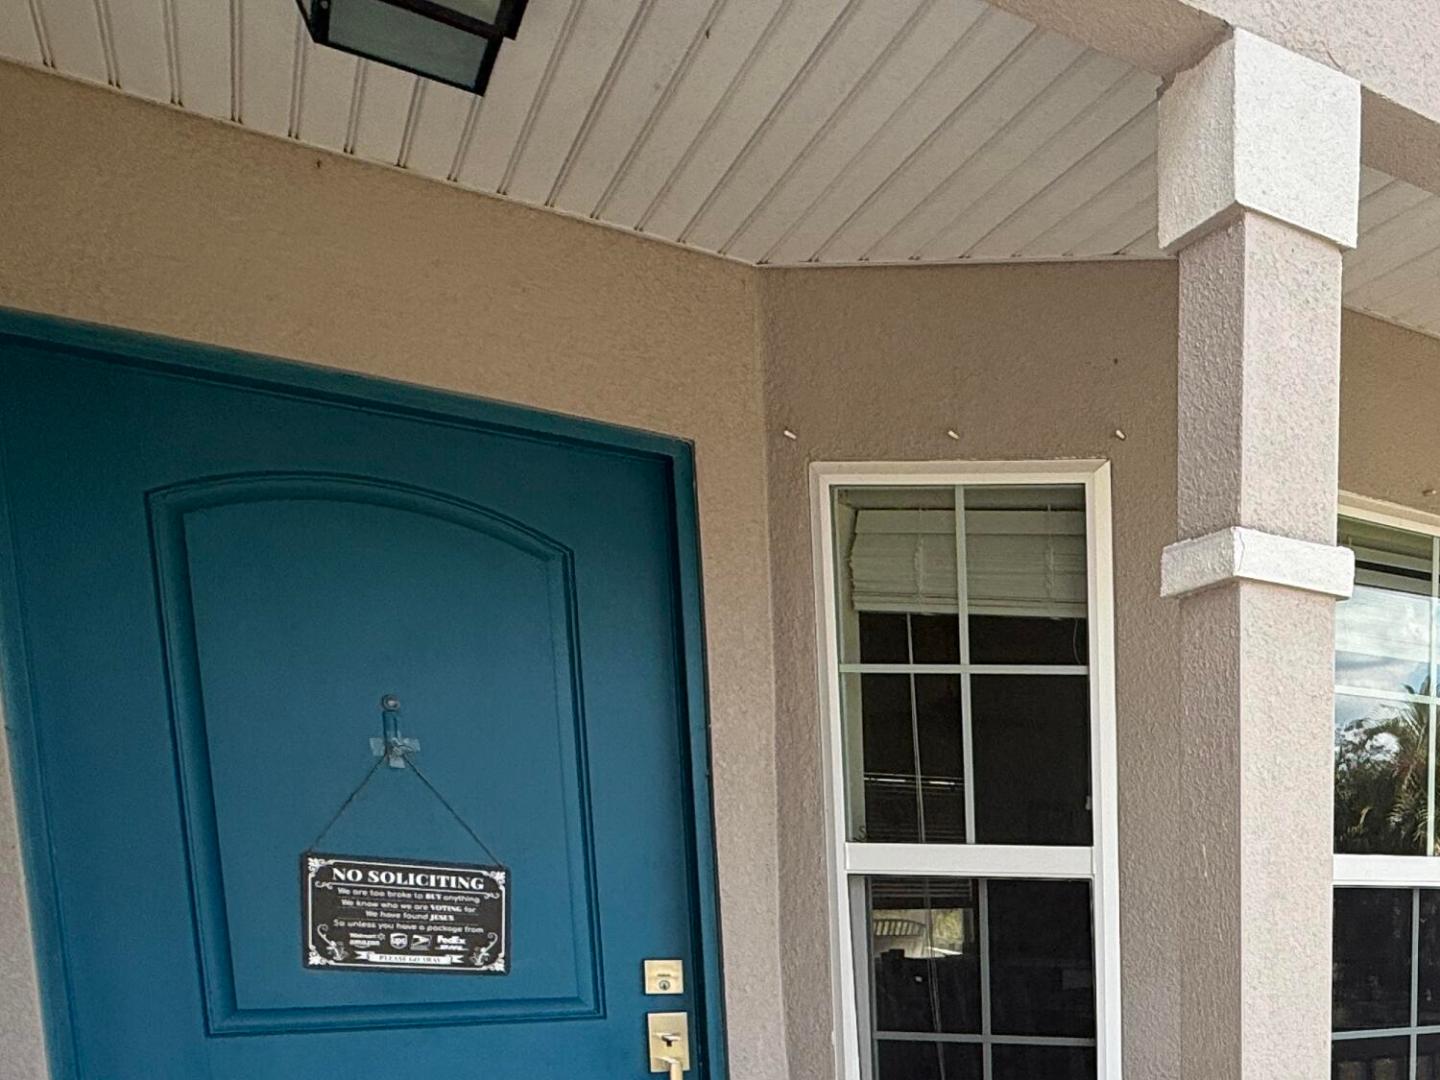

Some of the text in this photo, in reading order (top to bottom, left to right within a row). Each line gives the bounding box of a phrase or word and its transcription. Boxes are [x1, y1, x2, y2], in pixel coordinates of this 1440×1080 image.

[333, 868, 484, 890] NO SOLICITING
[338, 887, 351, 895] We
[387, 890, 411, 899] broke
[443, 895, 480, 904] anything
[430, 904, 462, 912] VOTING
[403, 912, 428, 920] found
[333, 919, 345, 927] So
[396, 922, 417, 930] have
[427, 925, 462, 933] package
